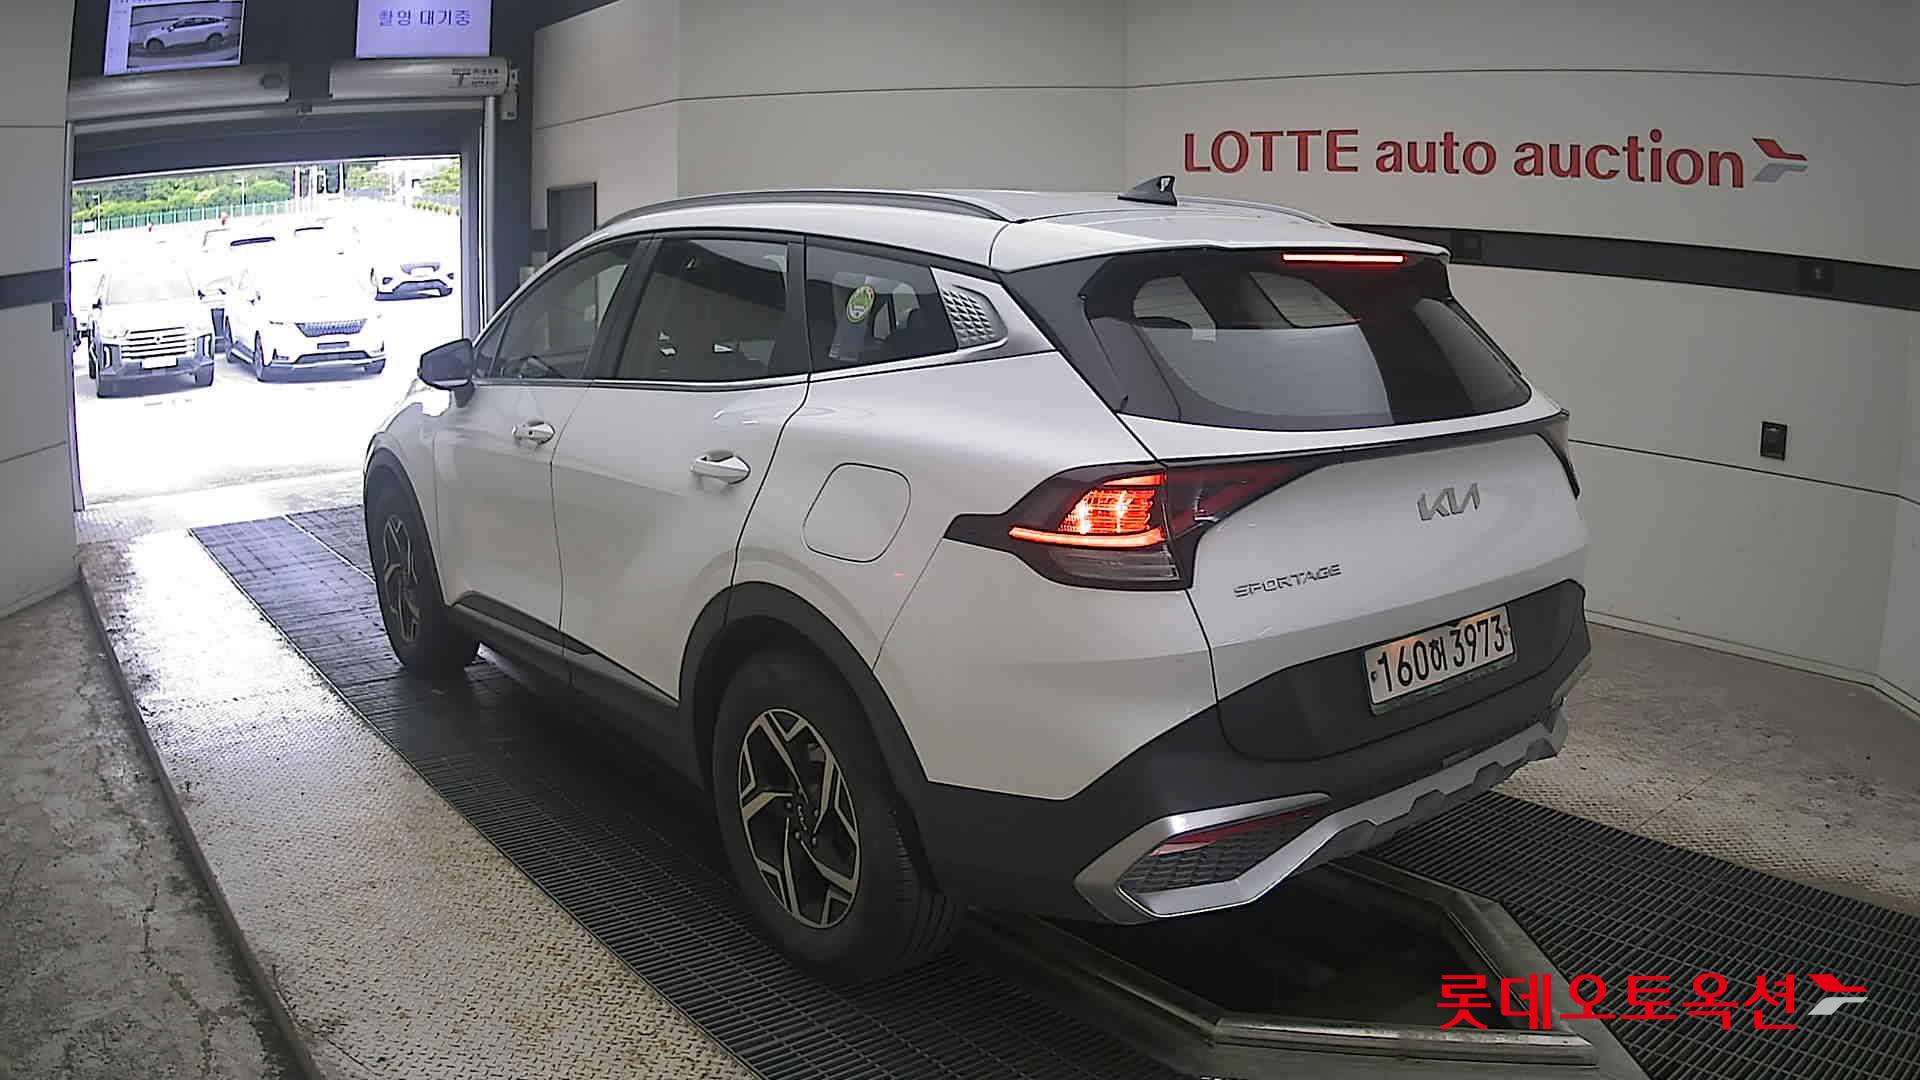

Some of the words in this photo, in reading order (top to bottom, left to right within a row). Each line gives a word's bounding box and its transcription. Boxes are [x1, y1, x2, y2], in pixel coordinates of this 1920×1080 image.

[419, 9, 472, 27] 대기중
[1184, 129, 1359, 173] LOTTE
[1375, 132, 1497, 174] auto
[1513, 129, 1744, 188] auction
[1233, 563, 1342, 597] SPORTAGE
